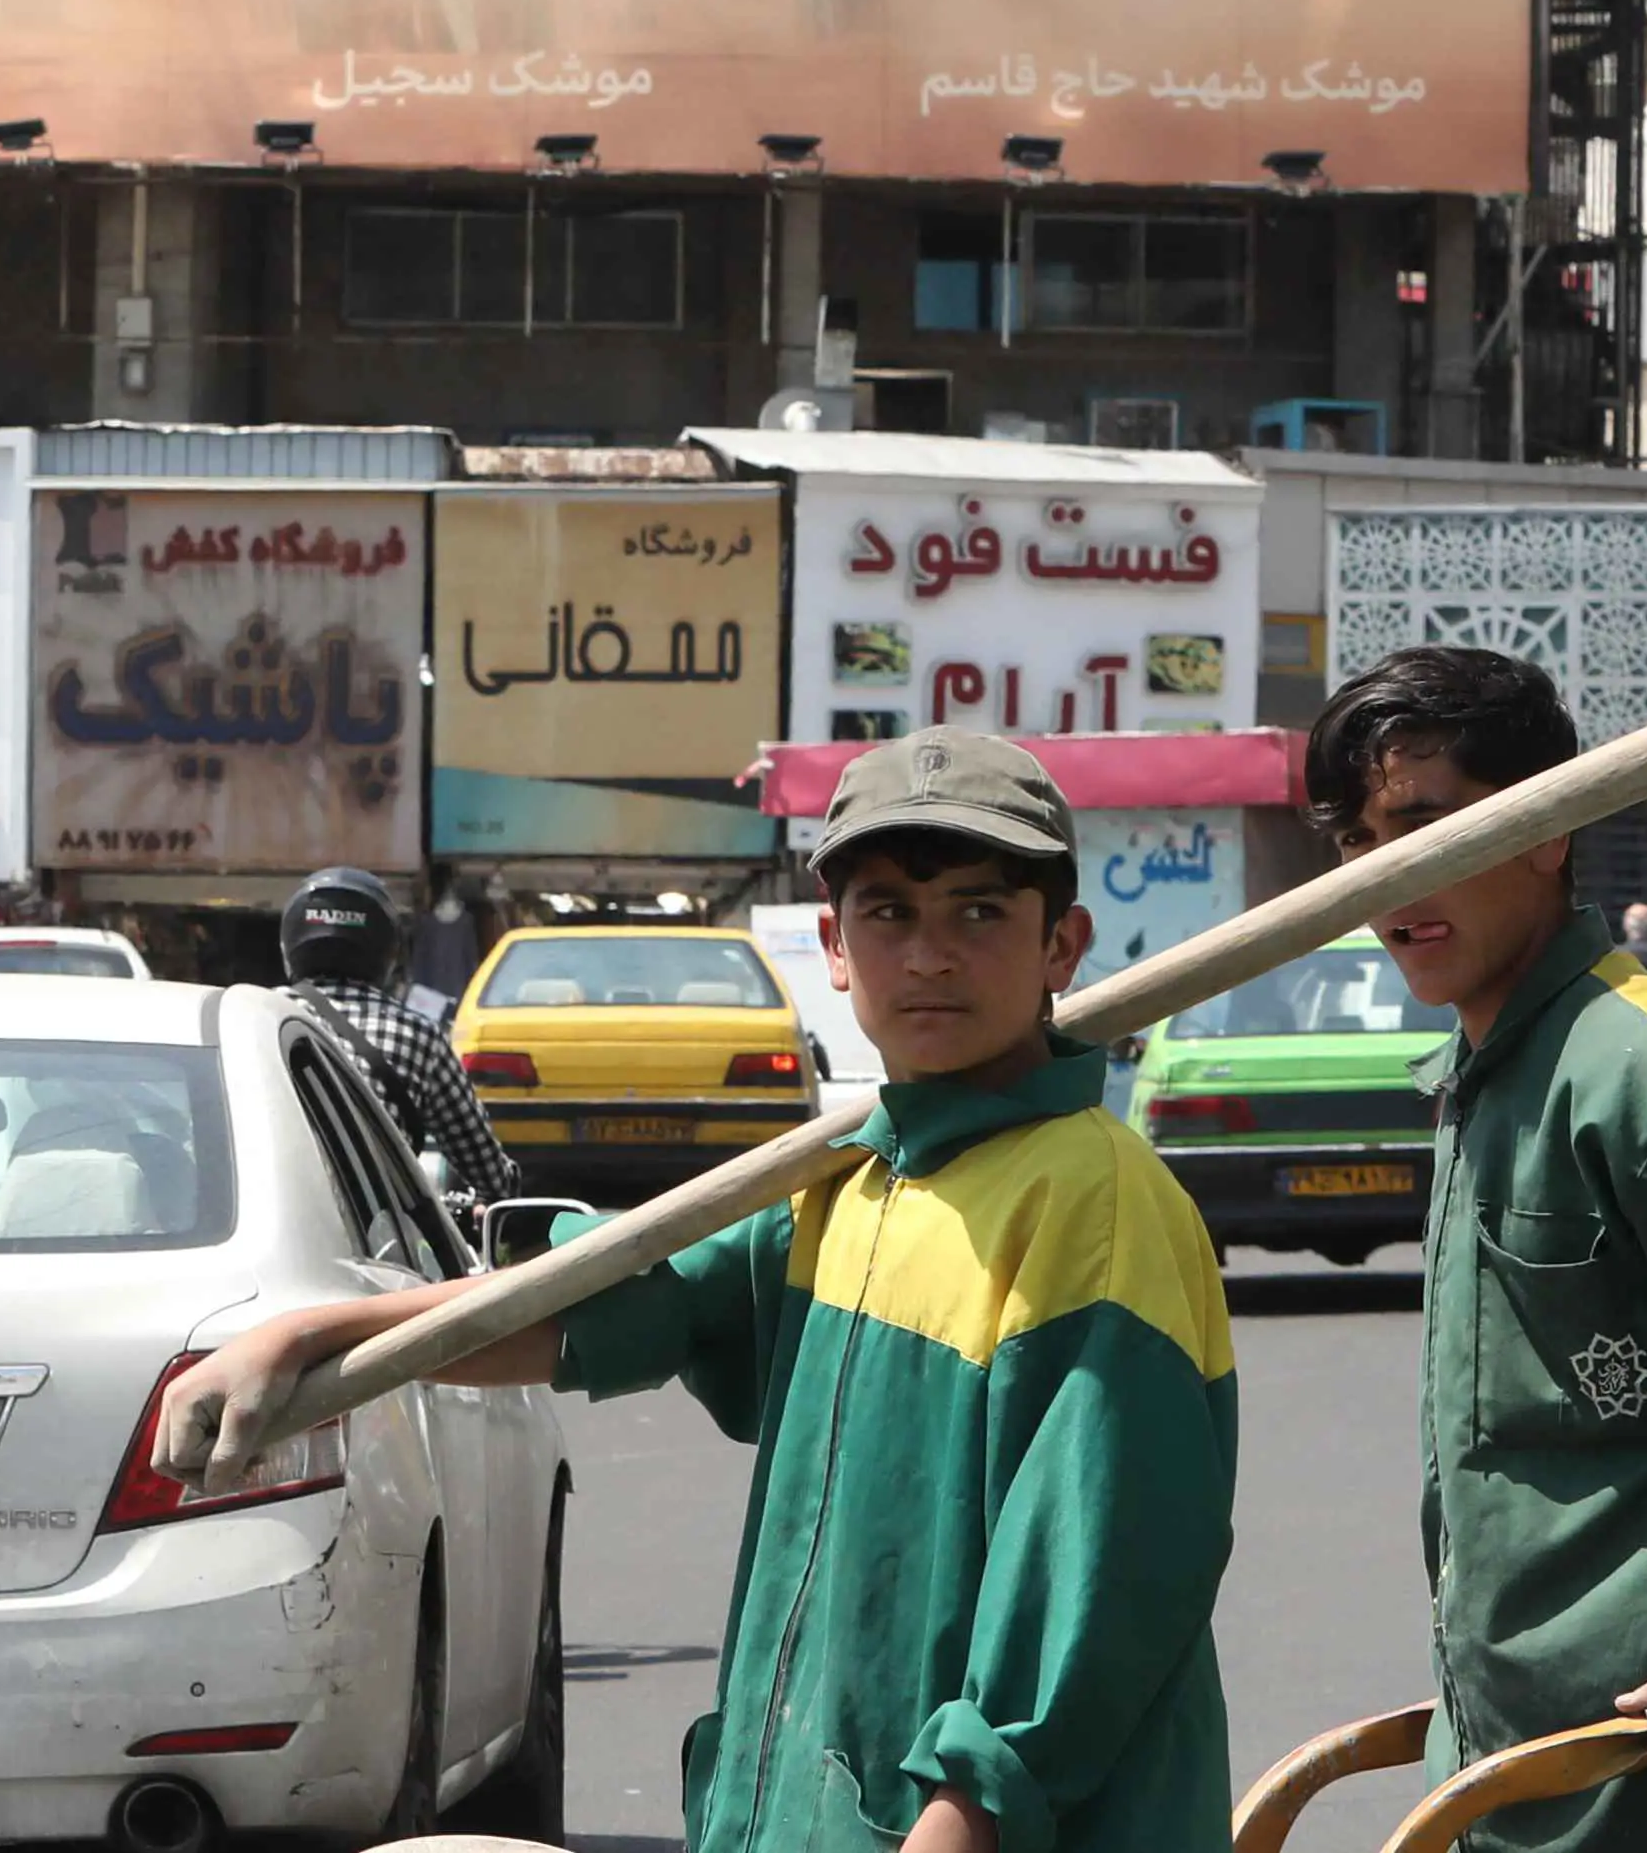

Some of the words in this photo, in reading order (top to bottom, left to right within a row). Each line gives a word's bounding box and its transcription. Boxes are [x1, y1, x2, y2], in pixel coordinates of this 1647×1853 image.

[312, 49, 474, 110] سجیل
[488, 51, 653, 109] موشک
[920, 52, 1038, 116] قاسم
[1049, 54, 1137, 118] حاج
[1148, 60, 1267, 110] شهید
[1281, 58, 1427, 113] موشک
[140, 524, 241, 573] کفش
[248, 519, 407, 579] فروشگاه
[623, 522, 754, 567] فروشگاه
[848, 498, 1004, 600] فود
[1023, 501, 1222, 585] فست
[930, 654, 1130, 734] آرام
